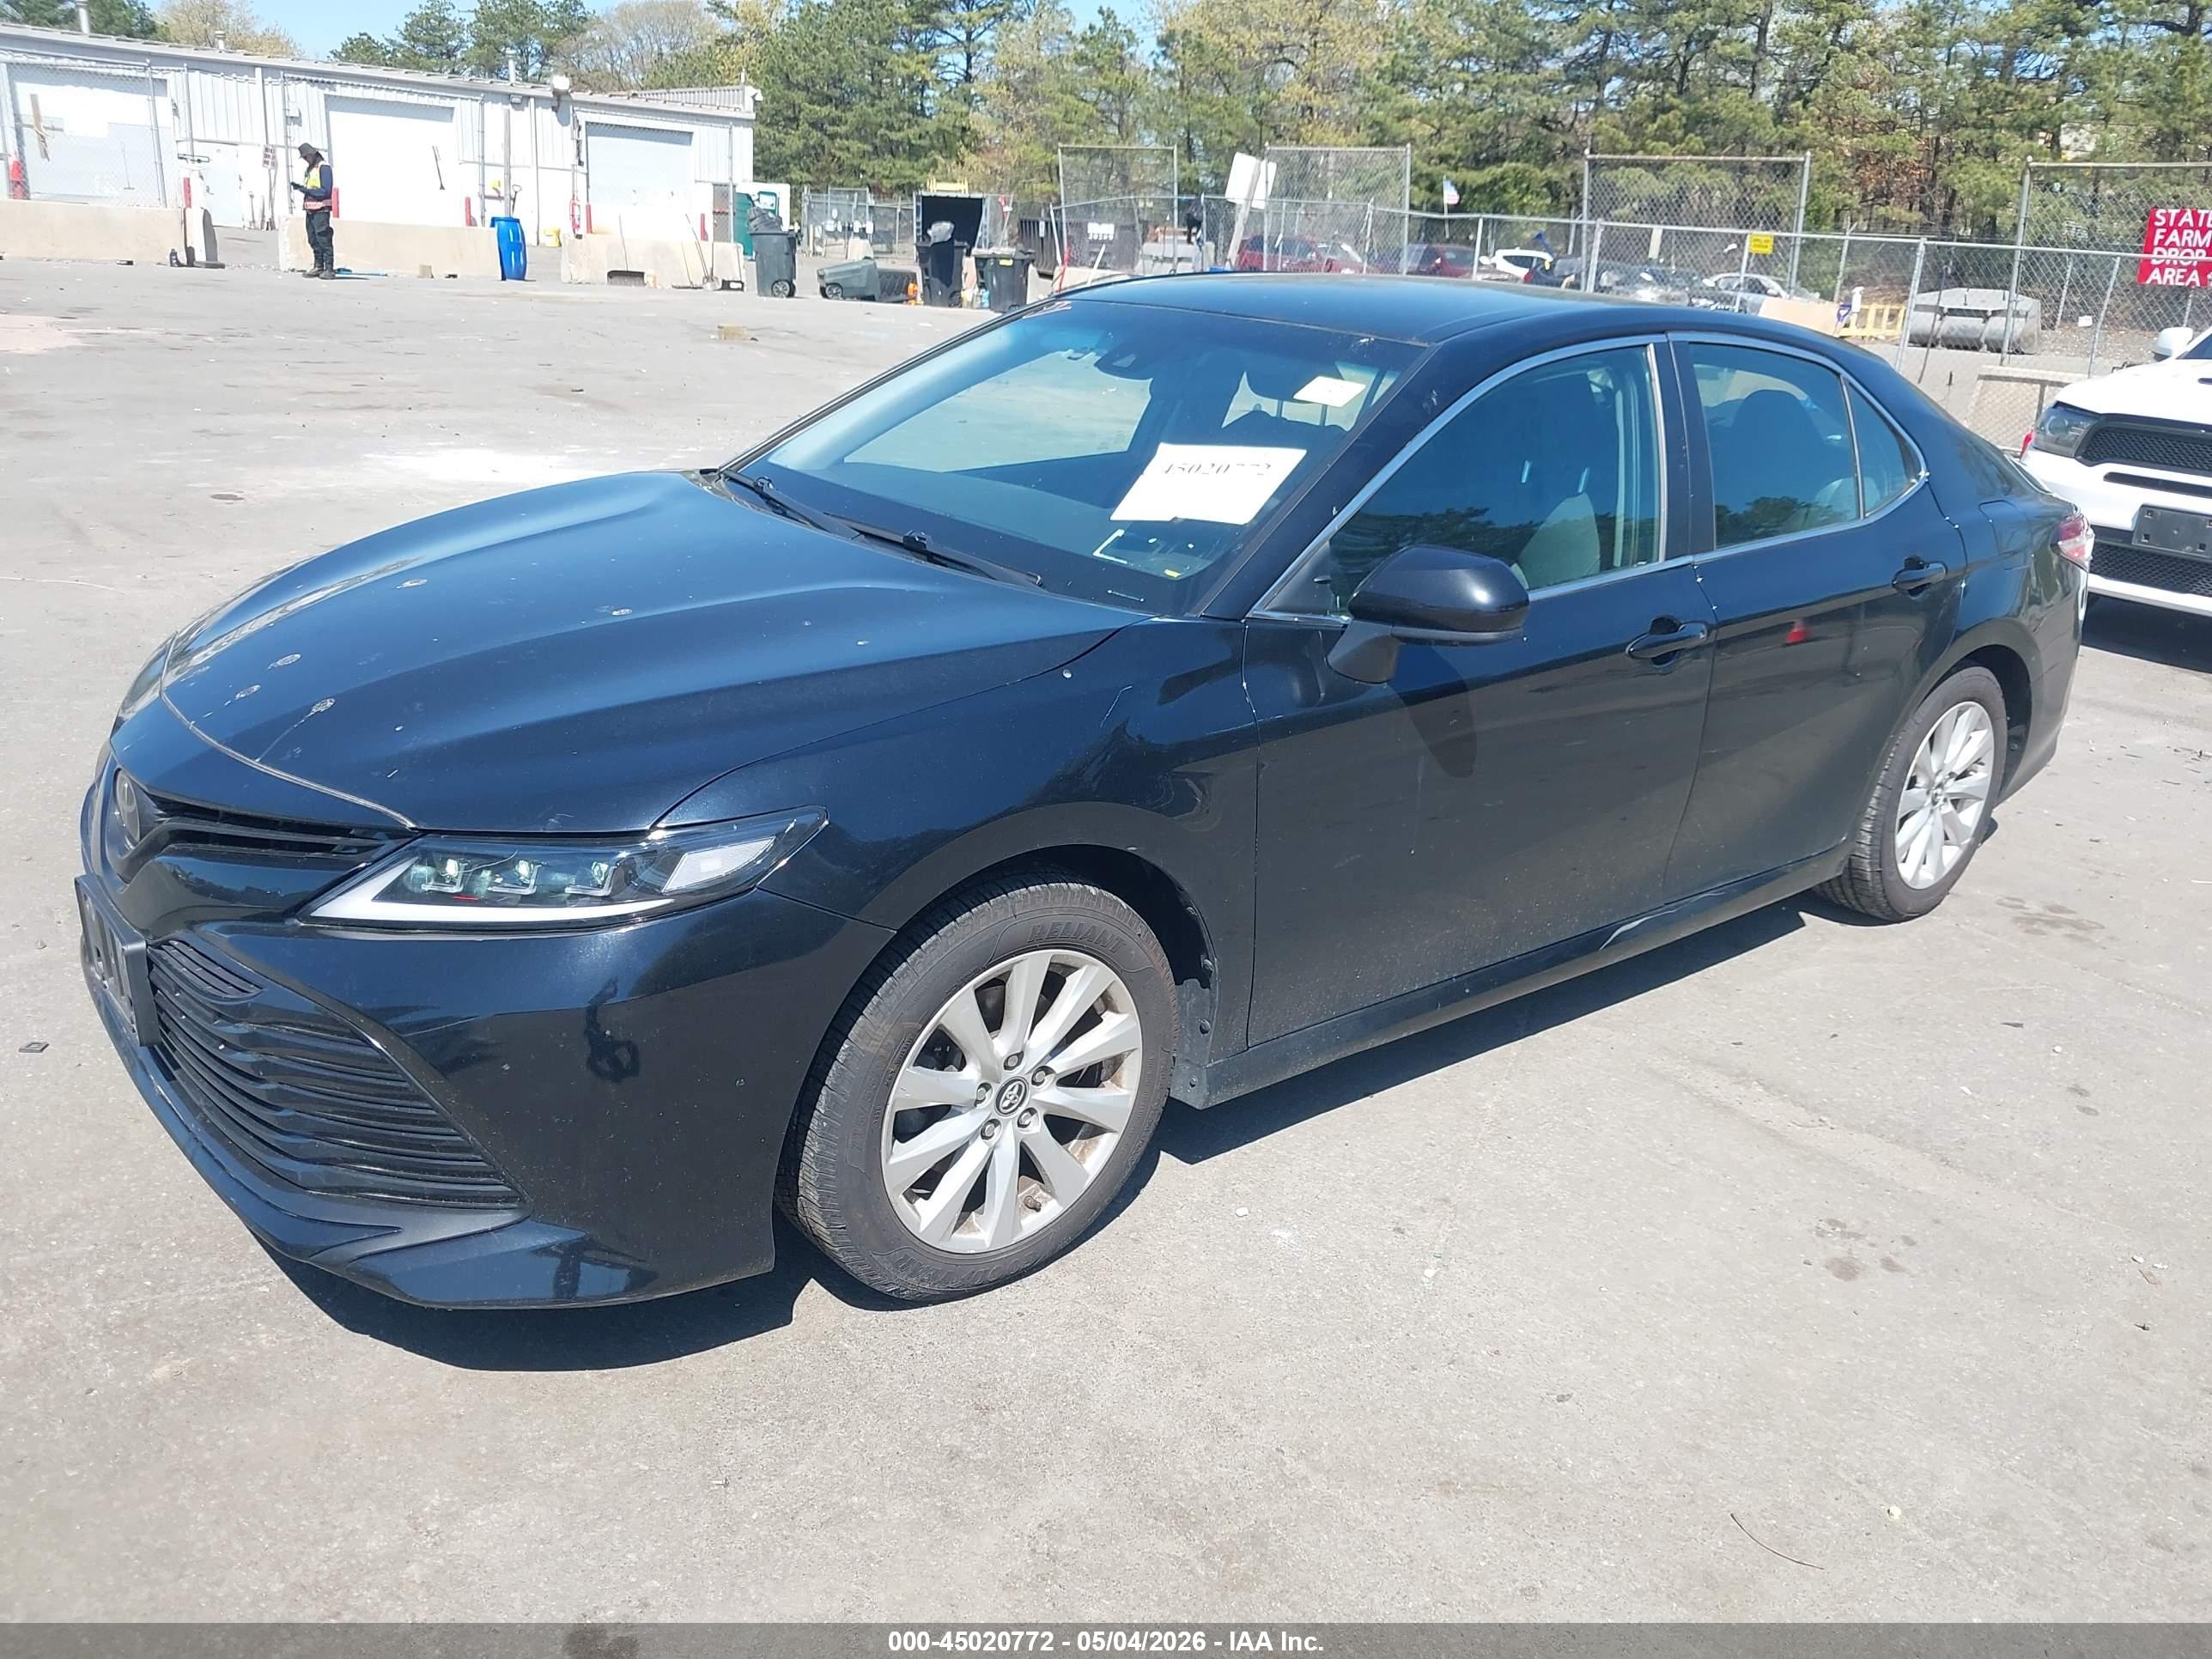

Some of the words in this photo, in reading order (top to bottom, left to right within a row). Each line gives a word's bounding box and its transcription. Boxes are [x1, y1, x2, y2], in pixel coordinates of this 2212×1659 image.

[2154, 209, 2212, 227] STATE
[2153, 228, 2212, 247] FARM
[2150, 246, 2207, 266] DROP
[2146, 267, 2201, 287] AREA
[1026, 921, 1126, 953] RELIANT
